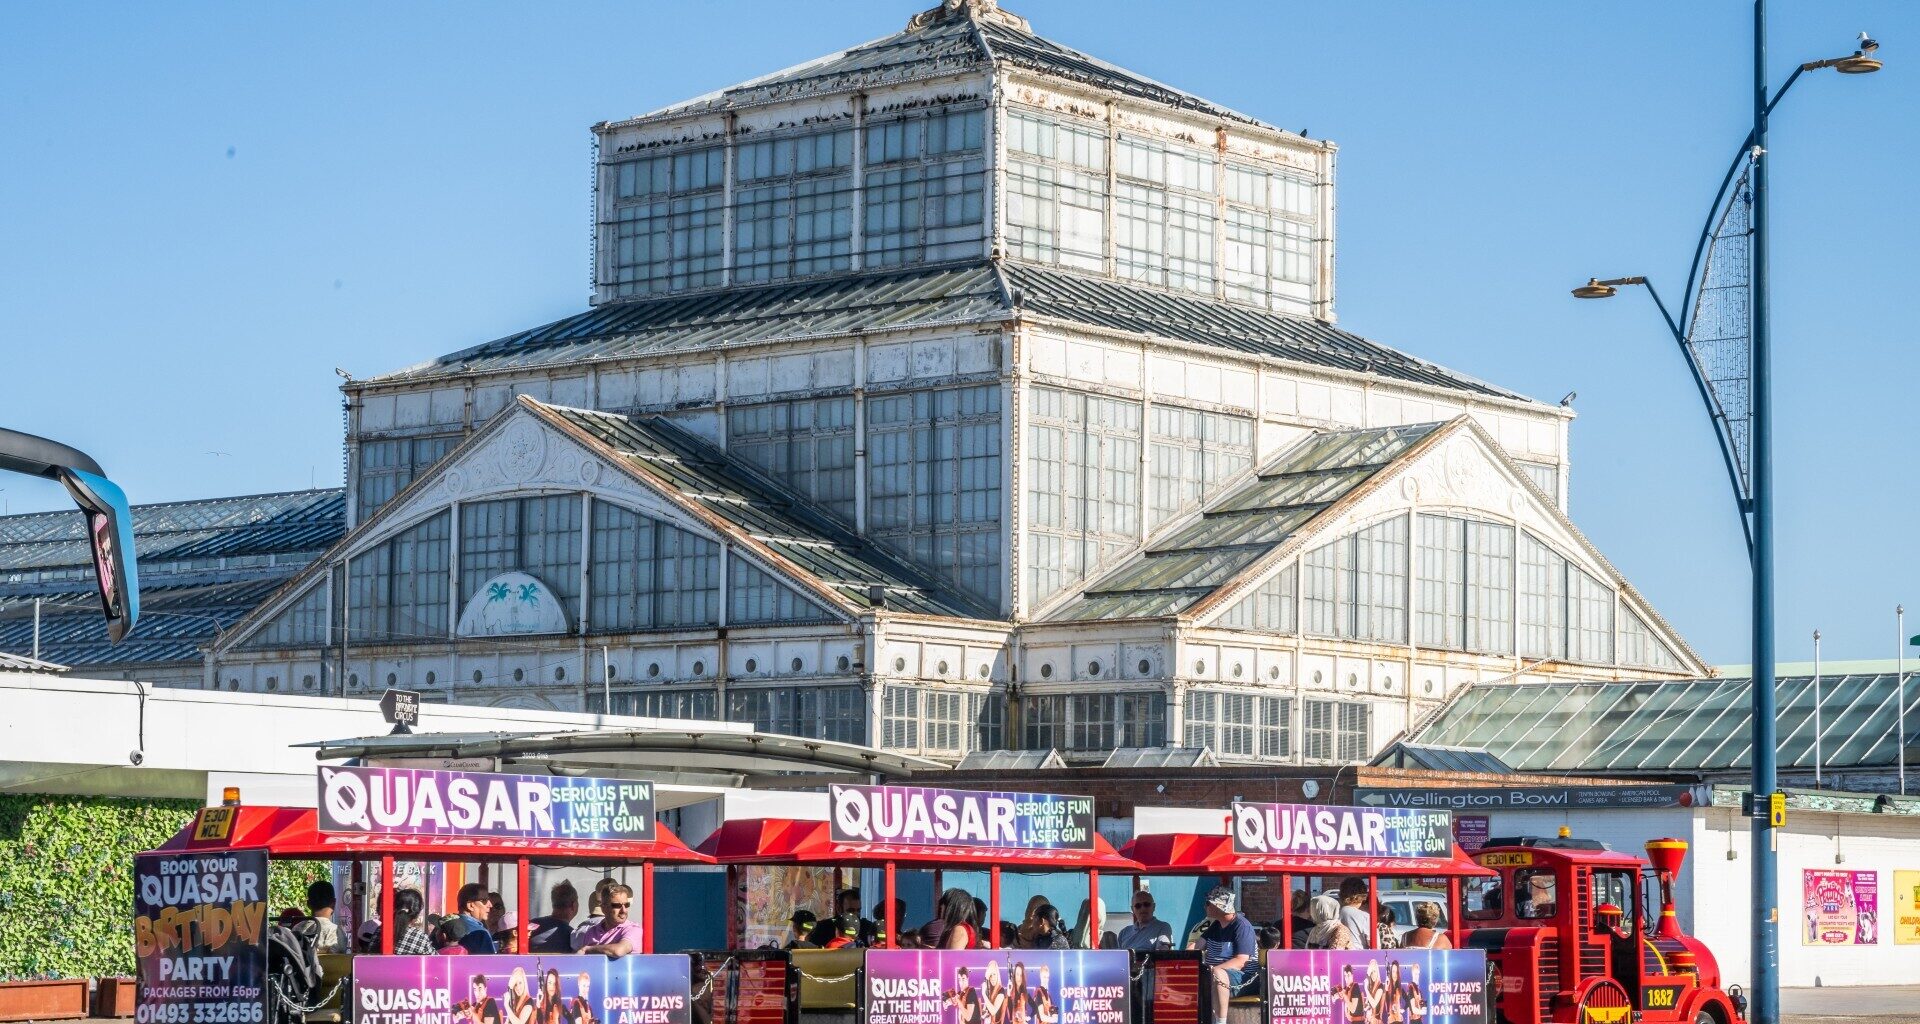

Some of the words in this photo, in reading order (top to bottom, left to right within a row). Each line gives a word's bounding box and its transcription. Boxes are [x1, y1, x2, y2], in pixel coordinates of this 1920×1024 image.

[395, 694, 403, 703] TO
[403, 695, 413, 704] THE
[394, 712, 414, 722] CIRCUS
[322, 767, 555, 833] QUASAR
[551, 785, 617, 804] SERIOUS
[620, 784, 650, 801] FUN
[1388, 792, 1503, 809] Wellington
[1510, 792, 1568, 805] Bowl
[575, 801, 615, 818] WITH
[618, 802, 630, 817] A
[832, 785, 1018, 842] QUASAR
[1016, 801, 1065, 816] SERIOUS
[1068, 800, 1091, 815] FUN
[203, 809, 229, 824] E301
[1034, 814, 1064, 829] WITH
[1066, 814, 1075, 828] A
[1385, 814, 1427, 829] SERIOUS
[1428, 813, 1449, 827] FUN
[200, 824, 221, 839] WCL
[561, 817, 610, 835] LASER
[613, 815, 645, 832] GUN
[1234, 804, 1387, 853] QUASAR
[1022, 828, 1060, 844] LASER
[1061, 827, 1086, 842] GUN
[1401, 826, 1426, 840] WITH
[1427, 827, 1435, 839] A
[1391, 839, 1422, 854] LASER
[1424, 838, 1446, 852] GUN
[160, 860, 199, 875] BOOK
[201, 857, 238, 873] YOUR
[1486, 854, 1507, 865] E301
[140, 872, 259, 907] QUASAR
[135, 899, 267, 958] BIRTHDAY
[159, 956, 235, 982] PARTY
[870, 976, 941, 998] QUASAR
[1272, 974, 1330, 993] QUASAR
[1429, 983, 1452, 993] OPEN
[1453, 983, 1459, 993] 7
[1459, 982, 1482, 993] DAYS
[143, 986, 196, 998] PACKAGES
[199, 985, 230, 998] FROM
[1060, 987, 1088, 999] OPEN
[1090, 987, 1097, 999] 7
[1098, 986, 1124, 998] DAYS
[1439, 994, 1446, 1004] A
[1446, 994, 1472, 1004] WEEK
[1647, 989, 1674, 1007] 1887
[360, 987, 450, 1012] QUASAR
[603, 996, 638, 1010] OPEN
[640, 996, 649, 1010] 7
[651, 995, 683, 1009] DAYS
[870, 1000, 886, 1014] AT
[888, 1000, 912, 1013] THE
[913, 999, 942, 1013] MINT
[1072, 1000, 1082, 1011] A
[1082, 999, 1113, 1011] WEEK
[1272, 995, 1285, 1007] AT
[1287, 995, 1306, 1006] THE
[1307, 994, 1331, 1006] MINT
[136, 1003, 190, 1024] 01493
[193, 1002, 263, 1023] 332656
[361, 1013, 381, 1024] AT
[383, 1013, 413, 1024] THE
[415, 1012, 451, 1024] MINT
[618, 1011, 629, 1024] A
[629, 1010, 669, 1024] WEEK
[1063, 1012, 1090, 1024] 10AM
[1097, 1011, 1123, 1023] 10PM
[1272, 1007, 1294, 1017] GREAT
[1295, 1006, 1332, 1017] YARMOUTH
[1430, 1006, 1453, 1016] 10AM
[1459, 1005, 1481, 1016] 10PM
[869, 1014, 897, 1024] GREAT
[898, 1014, 943, 1024] YARMOUTH
